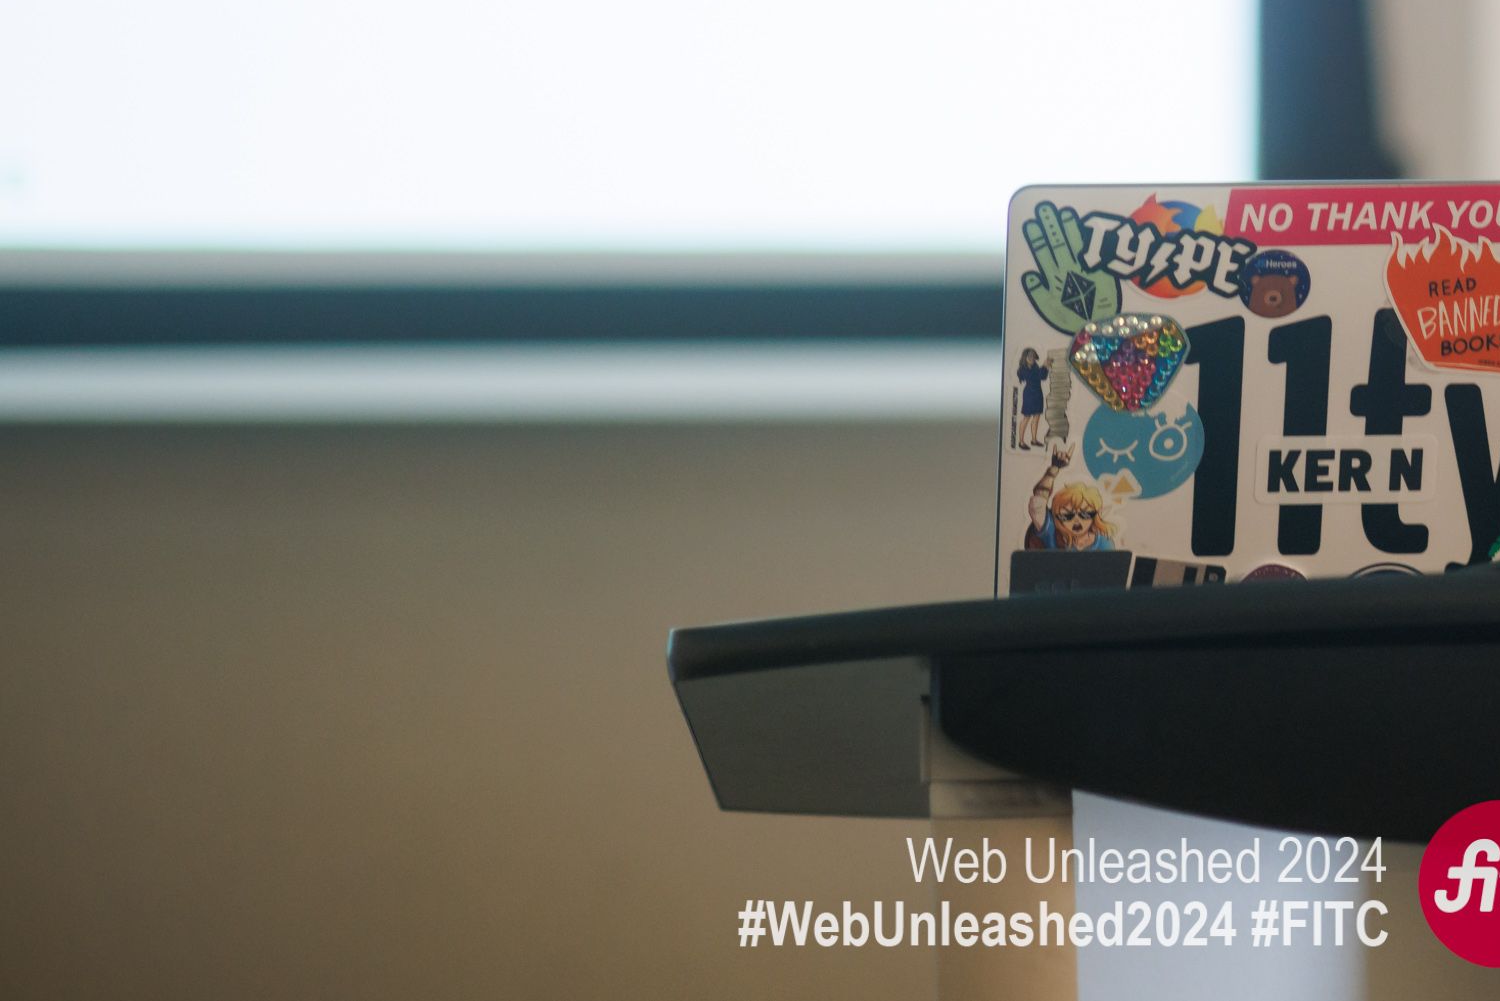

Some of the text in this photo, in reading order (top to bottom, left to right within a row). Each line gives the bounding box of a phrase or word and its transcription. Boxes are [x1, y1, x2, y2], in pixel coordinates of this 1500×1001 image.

[1239, 202, 1294, 233] NO
[1306, 200, 1433, 232] THANK
[1428, 278, 1477, 298] READ
